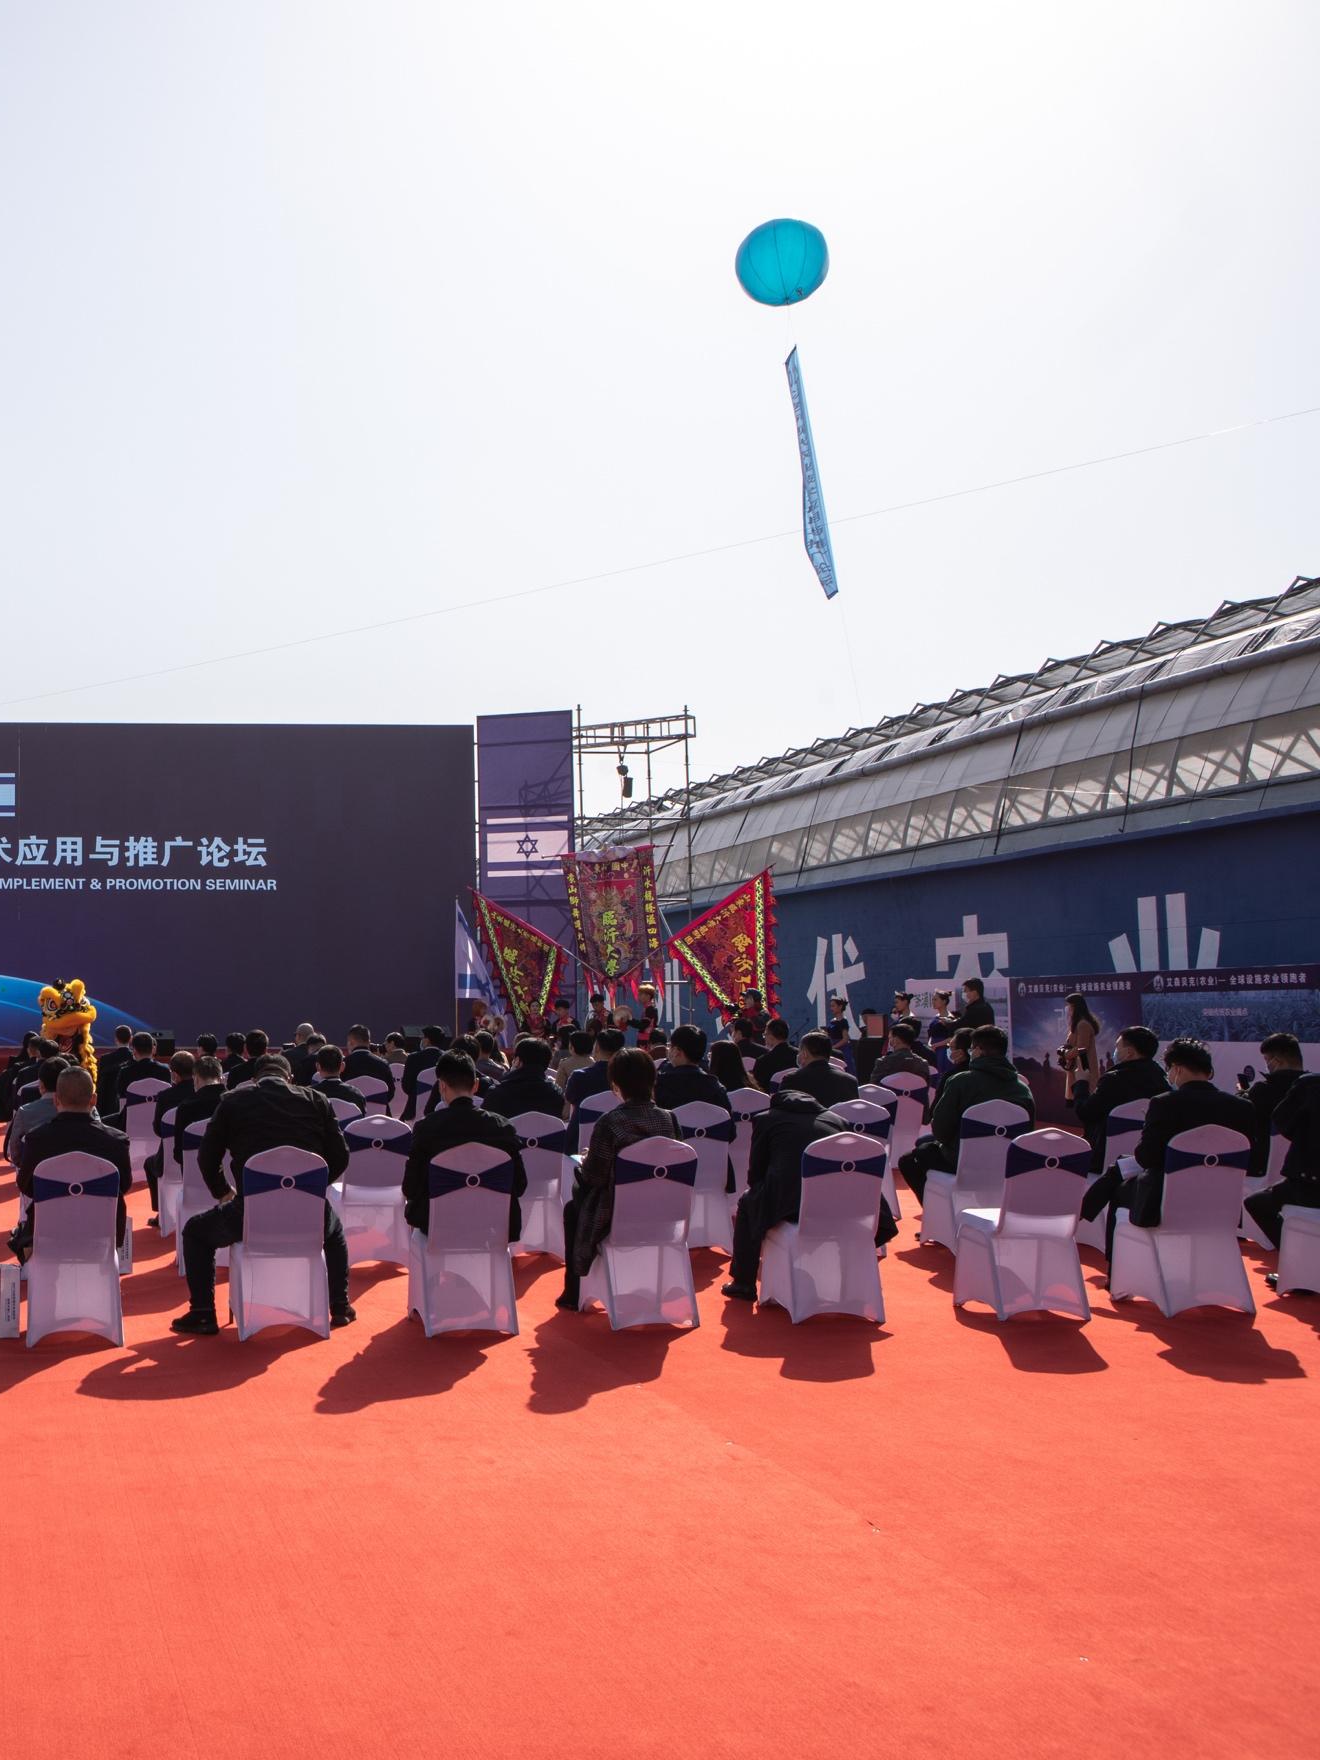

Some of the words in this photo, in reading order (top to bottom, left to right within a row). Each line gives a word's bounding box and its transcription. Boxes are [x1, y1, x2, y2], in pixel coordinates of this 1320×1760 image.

[89, 877, 102, 891] &
[106, 878, 202, 891] PROMOTION
[205, 878, 278, 891] SEMINAR
